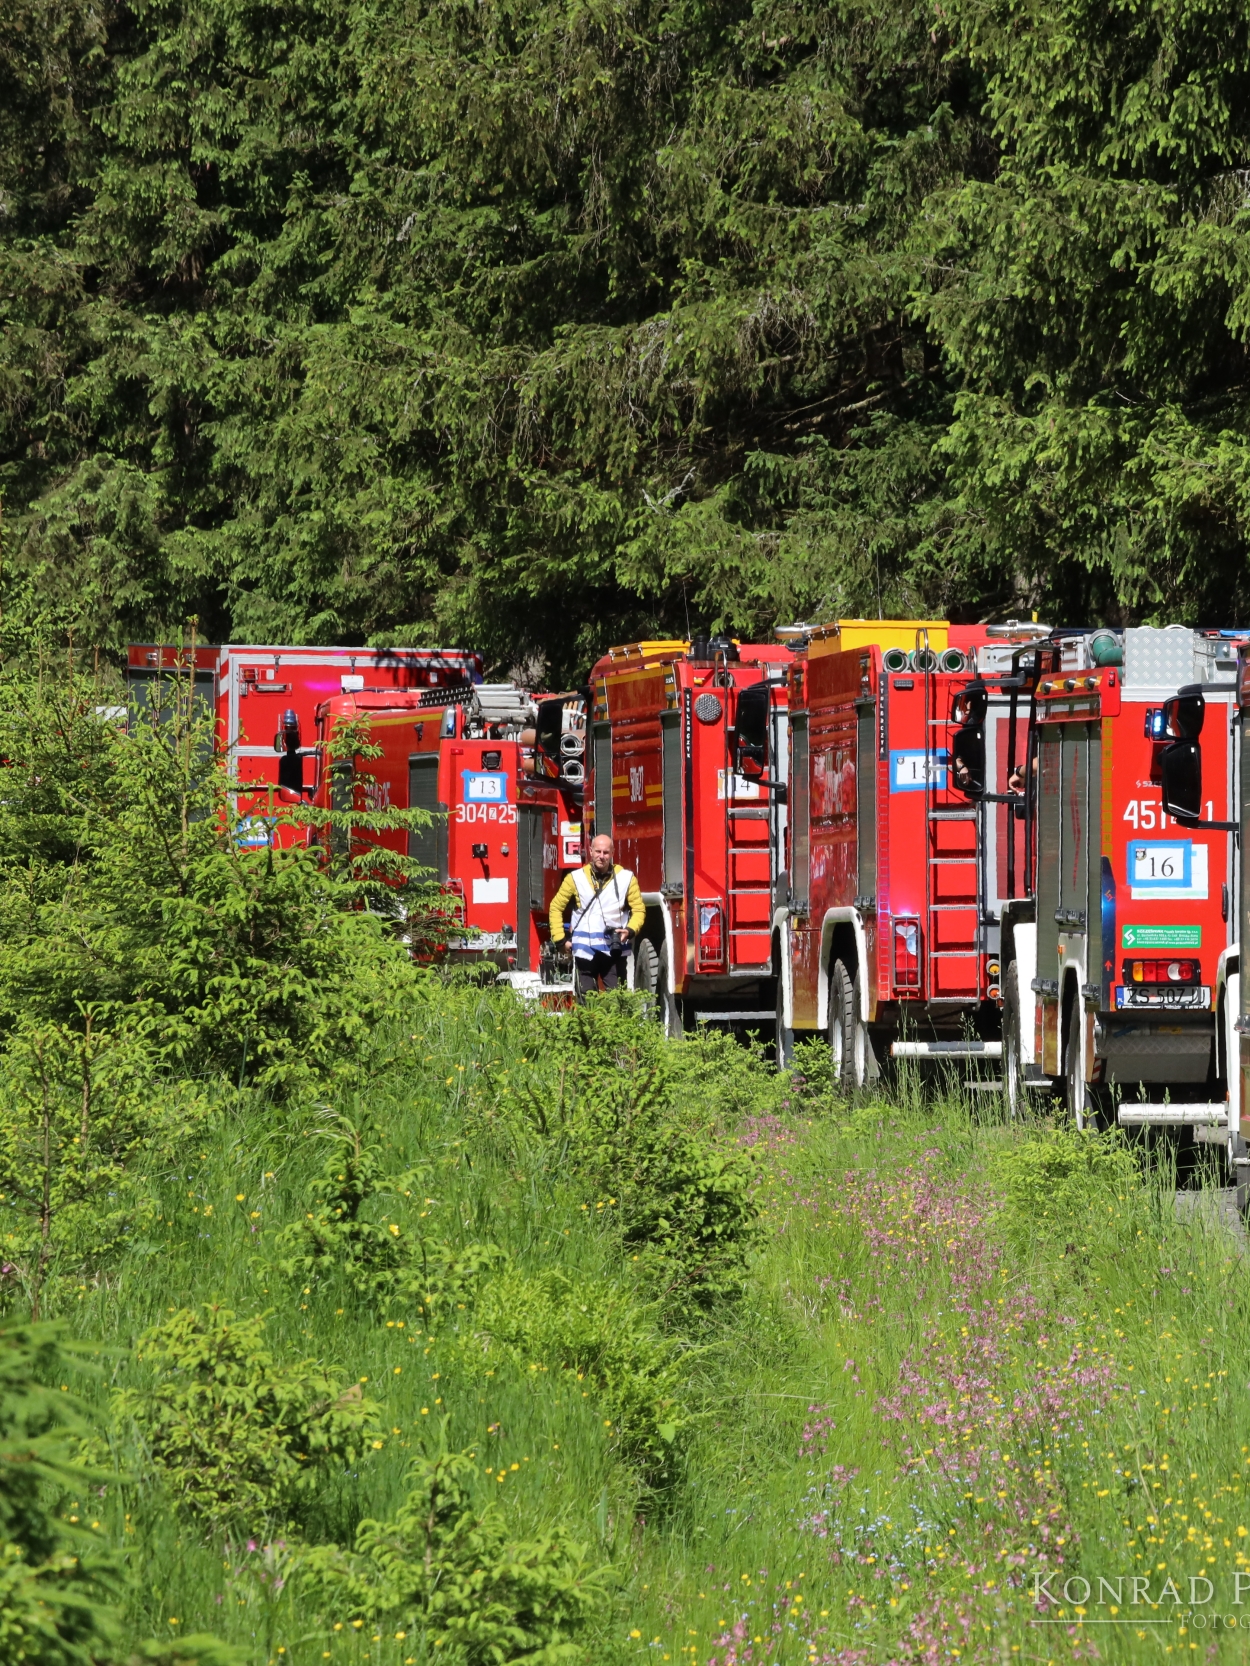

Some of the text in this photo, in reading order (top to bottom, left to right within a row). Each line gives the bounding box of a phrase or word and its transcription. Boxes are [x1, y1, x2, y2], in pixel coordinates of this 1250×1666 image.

[911, 760, 932, 779] 15
[480, 780, 497, 795] 13
[1122, 799, 1214, 830] 4511
[1149, 856, 1175, 878] 16
[1127, 987, 1151, 1004] ZS
